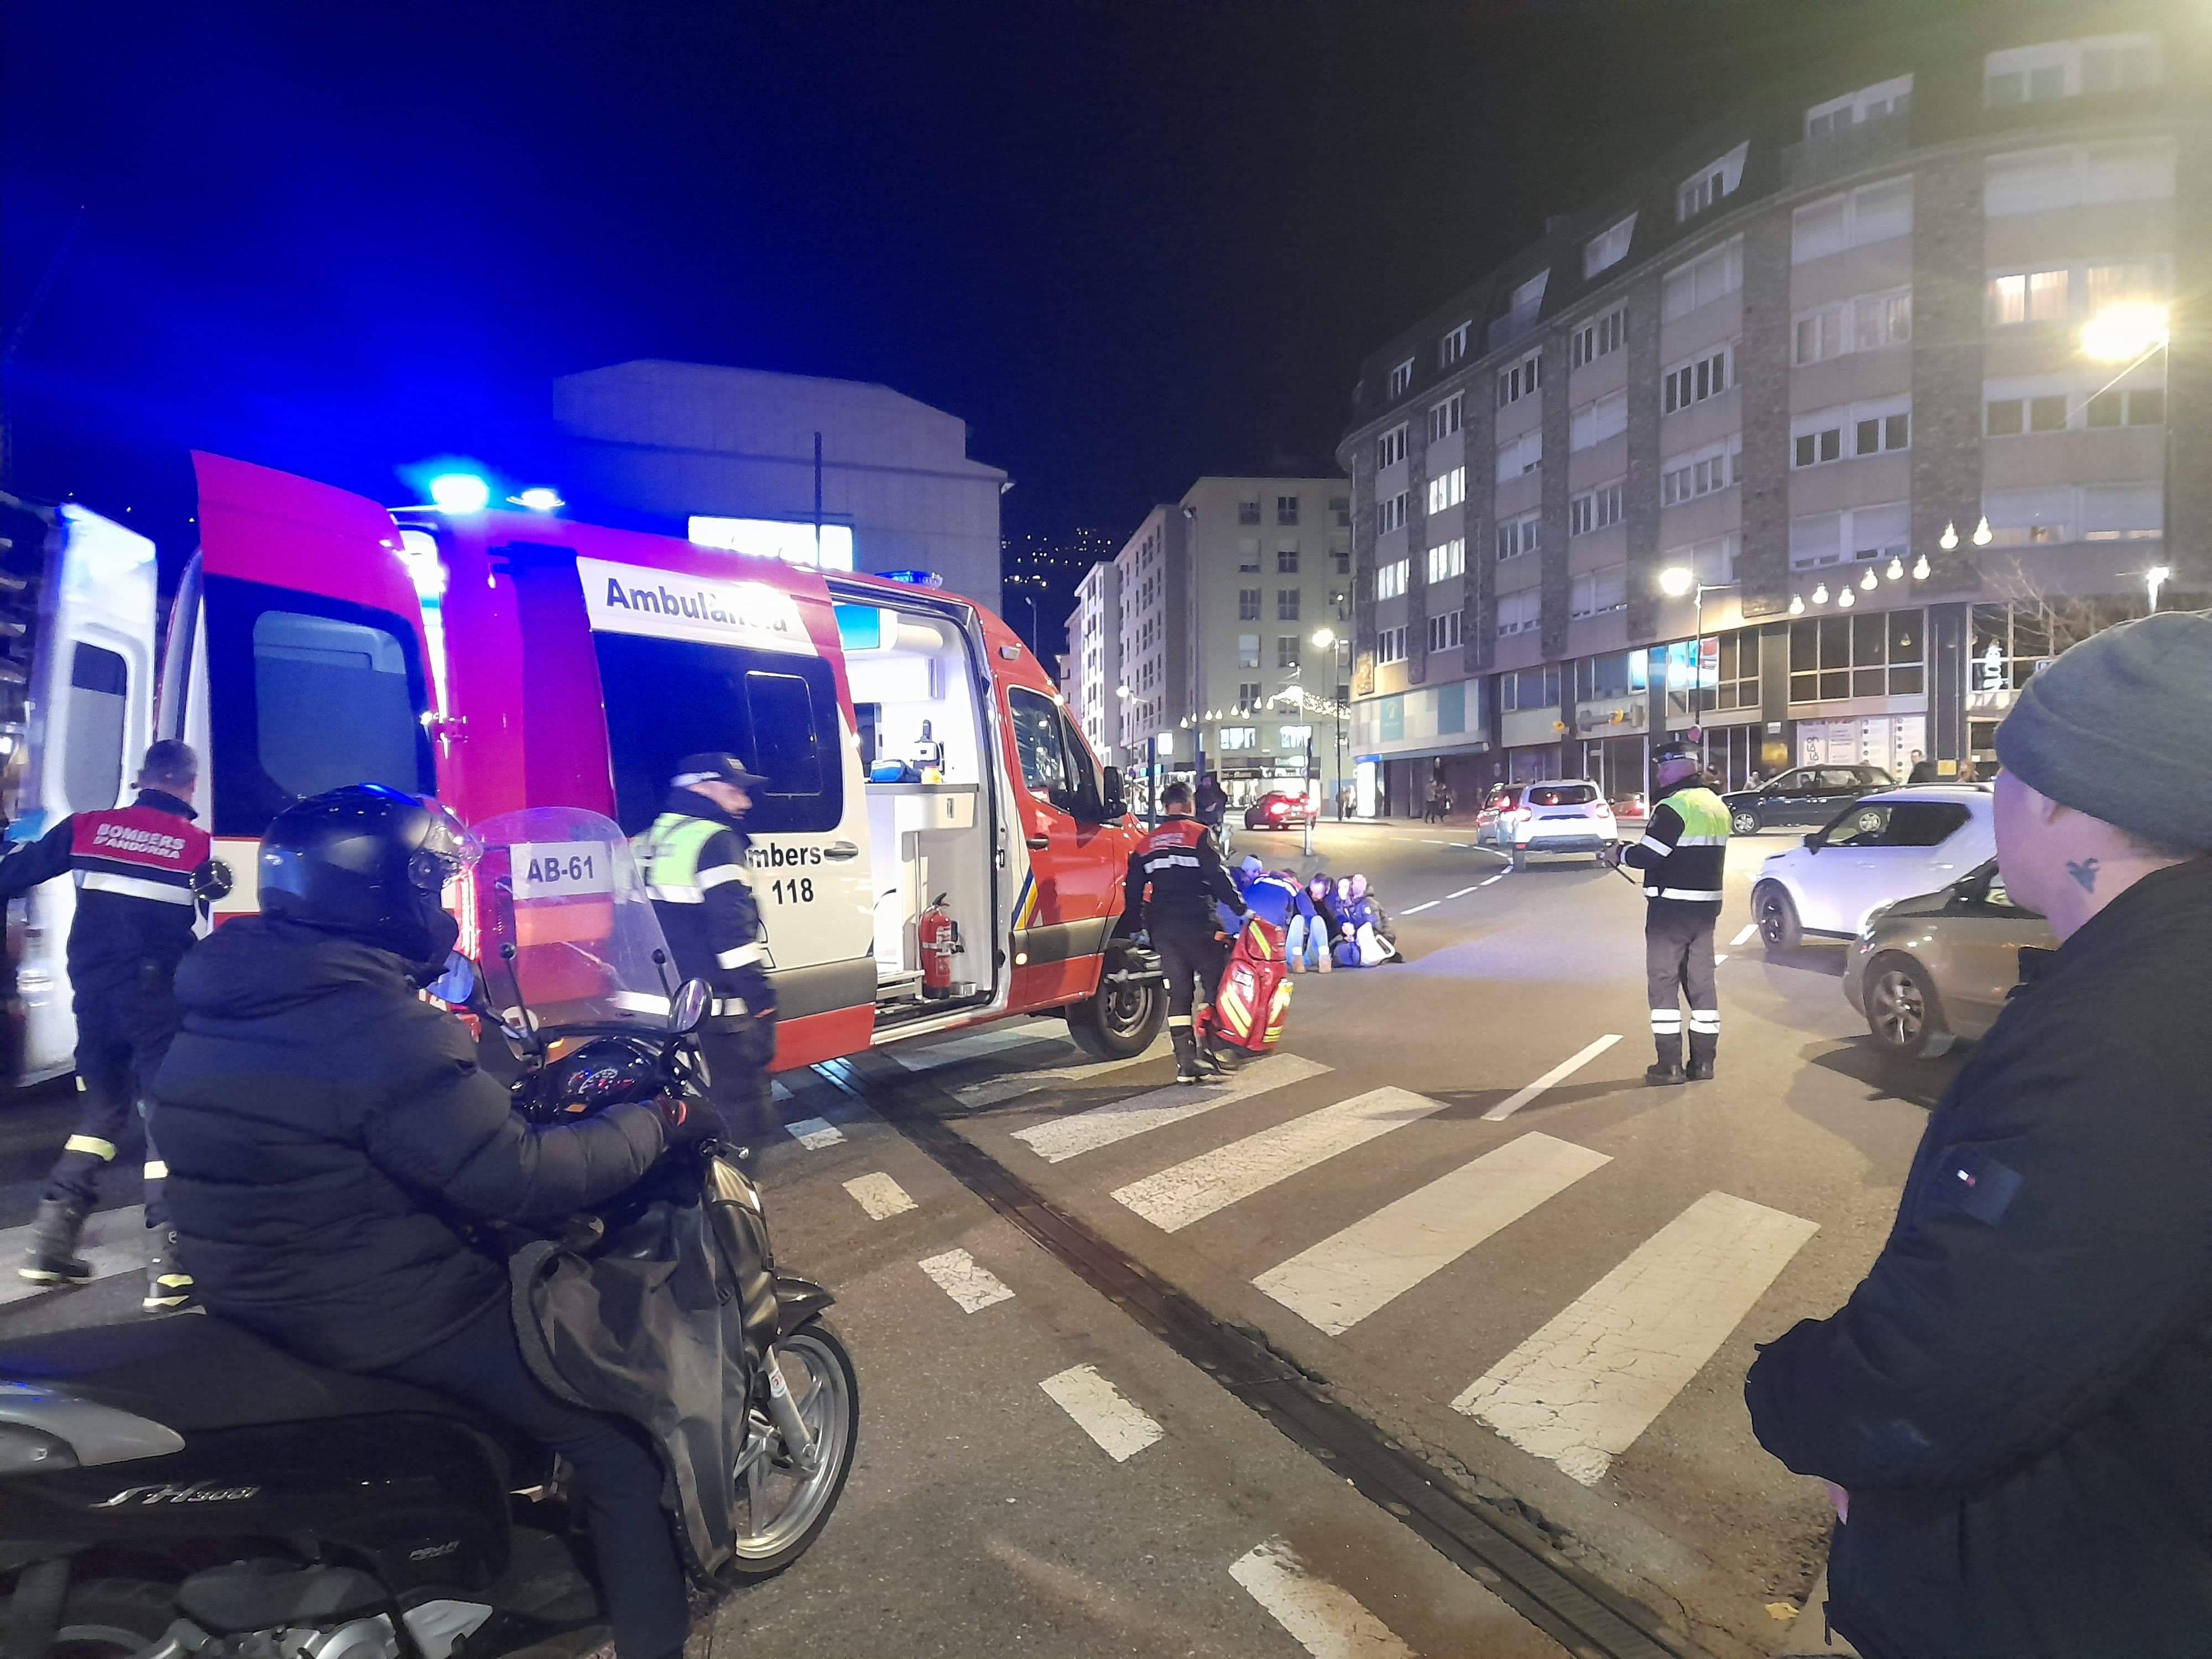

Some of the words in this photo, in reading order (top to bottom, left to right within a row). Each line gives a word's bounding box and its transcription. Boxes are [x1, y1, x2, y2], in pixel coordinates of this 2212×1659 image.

[528, 855, 593, 882] AB-61
[745, 842, 821, 868] mbers
[772, 878, 814, 905] 118
